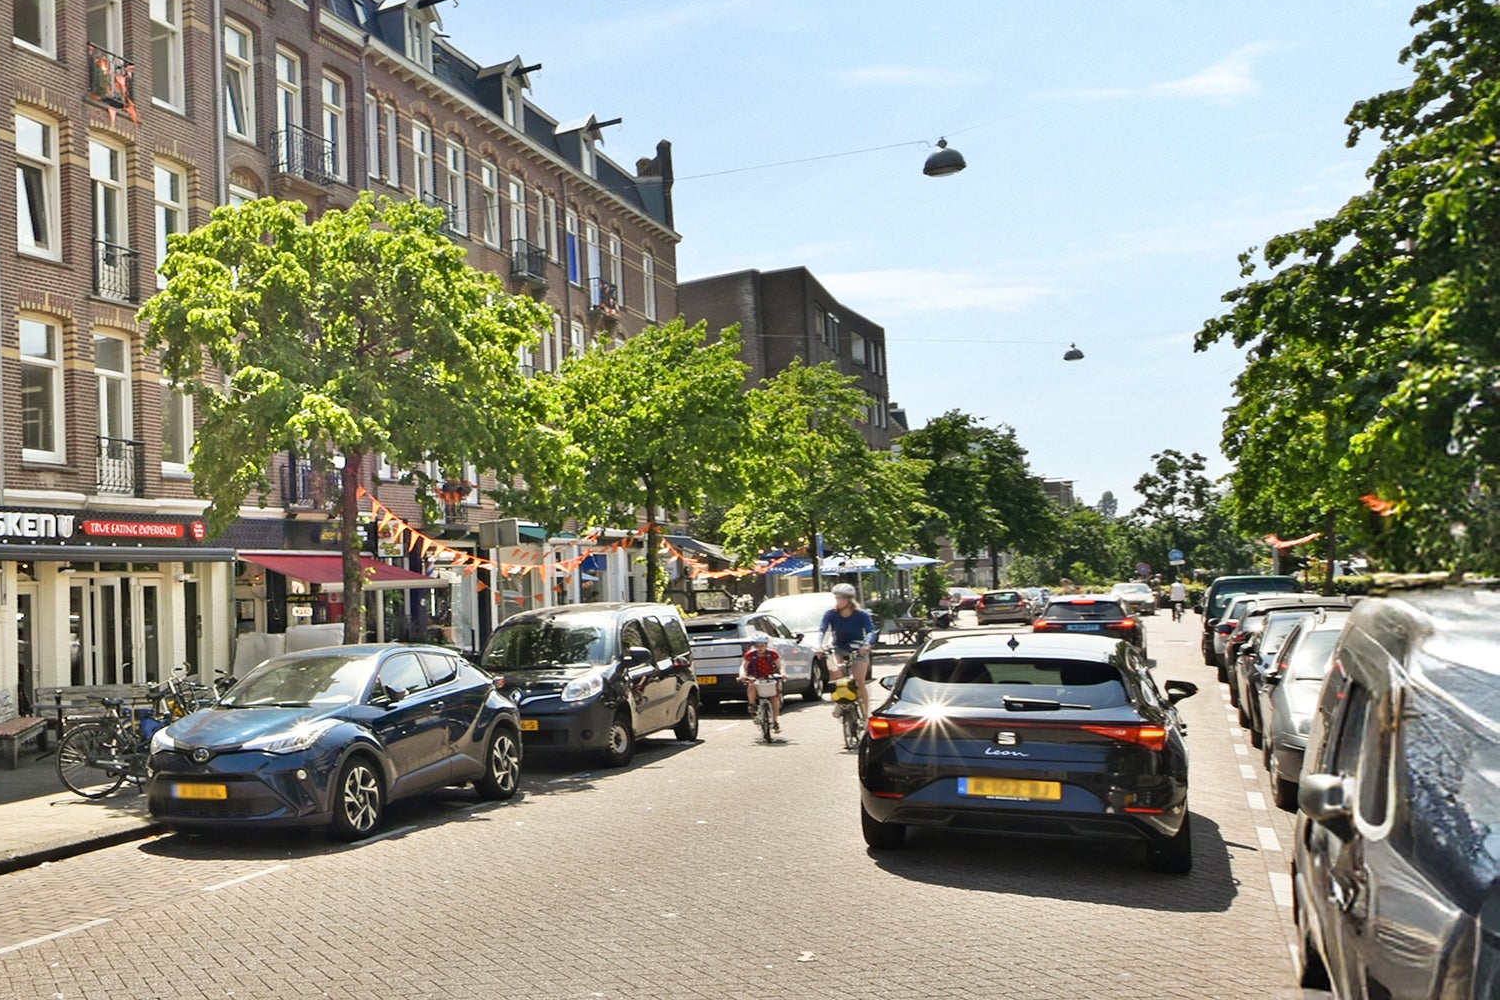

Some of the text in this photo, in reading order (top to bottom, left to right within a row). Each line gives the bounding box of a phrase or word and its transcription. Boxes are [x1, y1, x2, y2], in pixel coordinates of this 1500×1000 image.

[90, 523, 177, 536] TRUE EATING EXPERIENCE
[985, 747, 1030, 757] Leon
